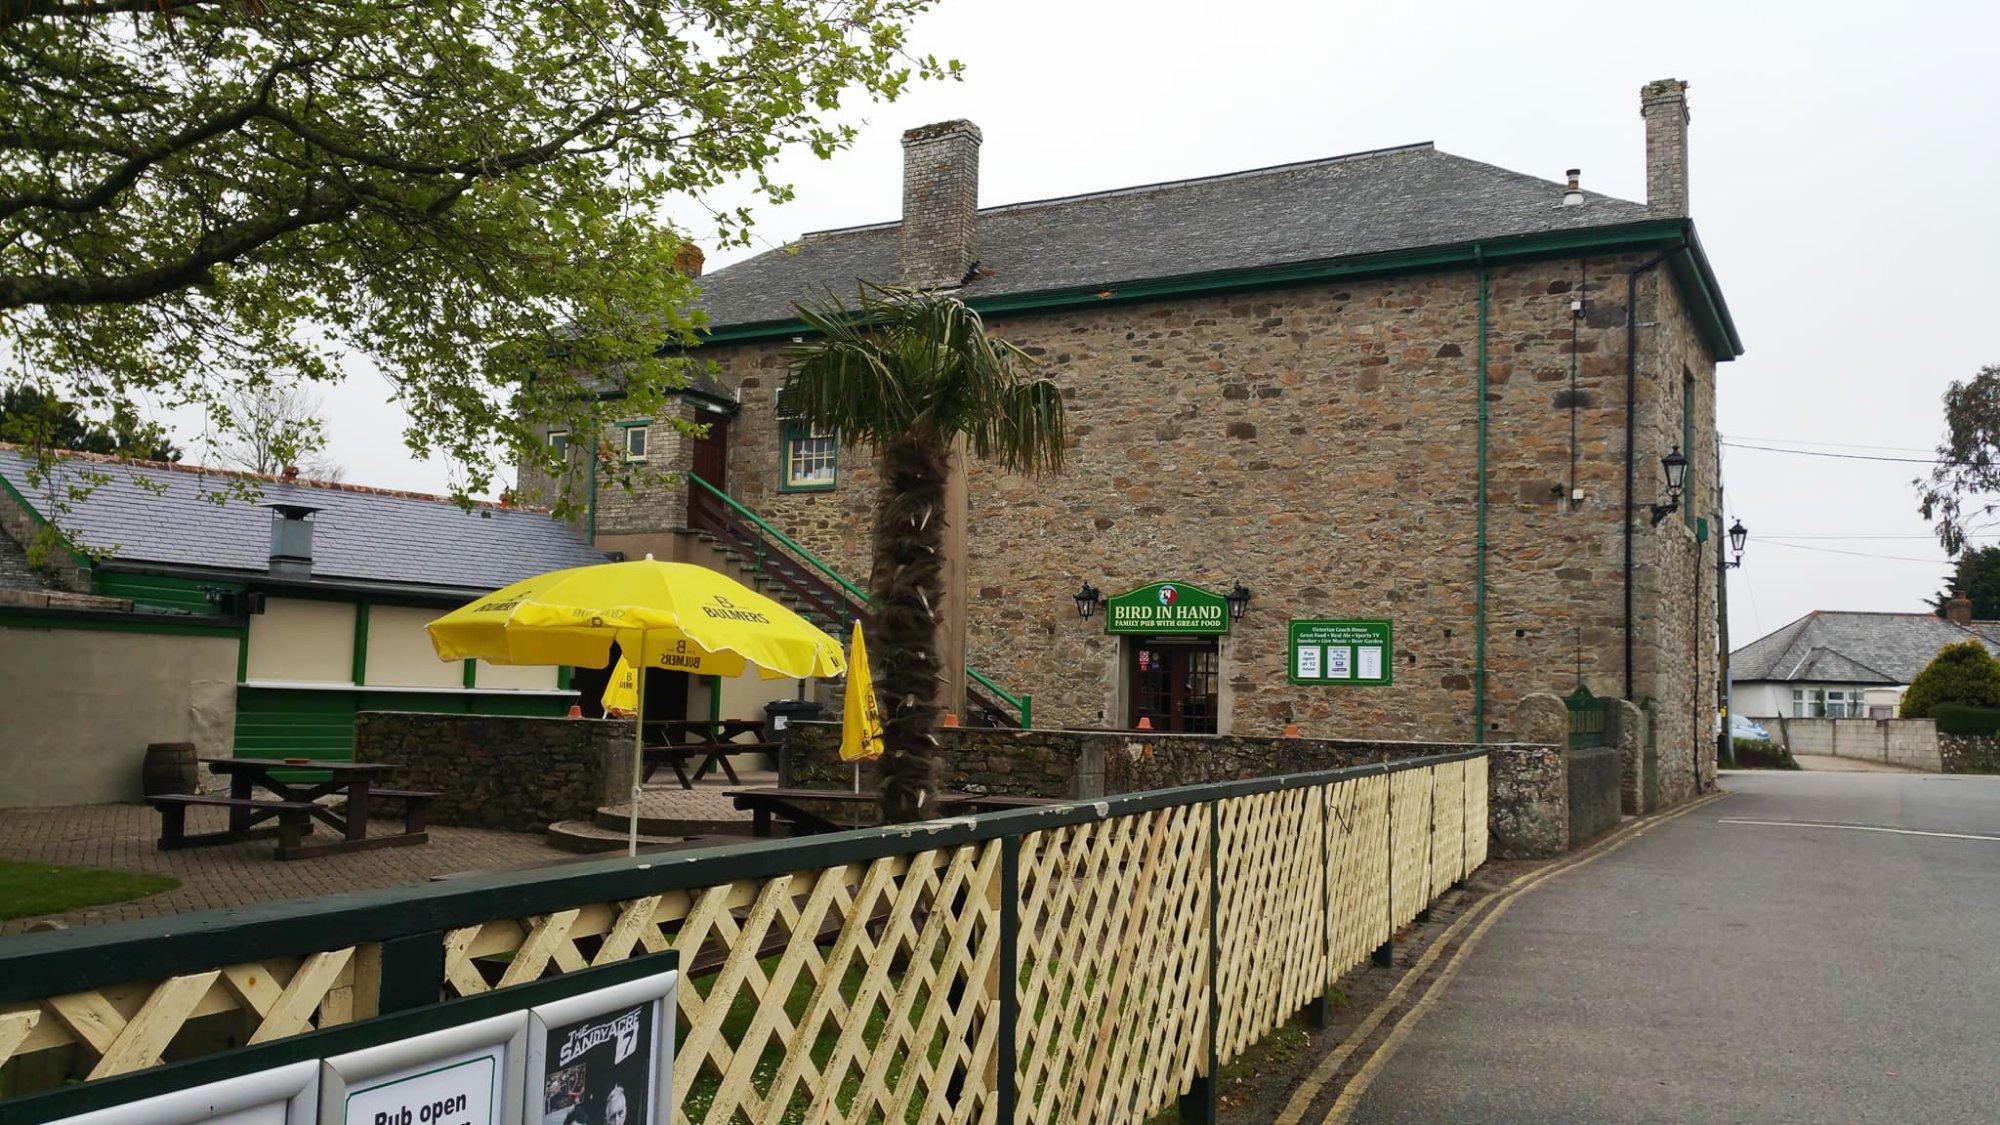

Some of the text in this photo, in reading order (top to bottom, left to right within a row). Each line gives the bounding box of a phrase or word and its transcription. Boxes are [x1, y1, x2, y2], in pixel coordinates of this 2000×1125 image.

[702, 606, 770, 624] BULMERS
[1115, 606, 1221, 619] BIRD IN HAND
[559, 1007, 642, 1067] SANDYACRE
[568, 1023, 590, 1040] THE
[419, 1093, 467, 1125] open
